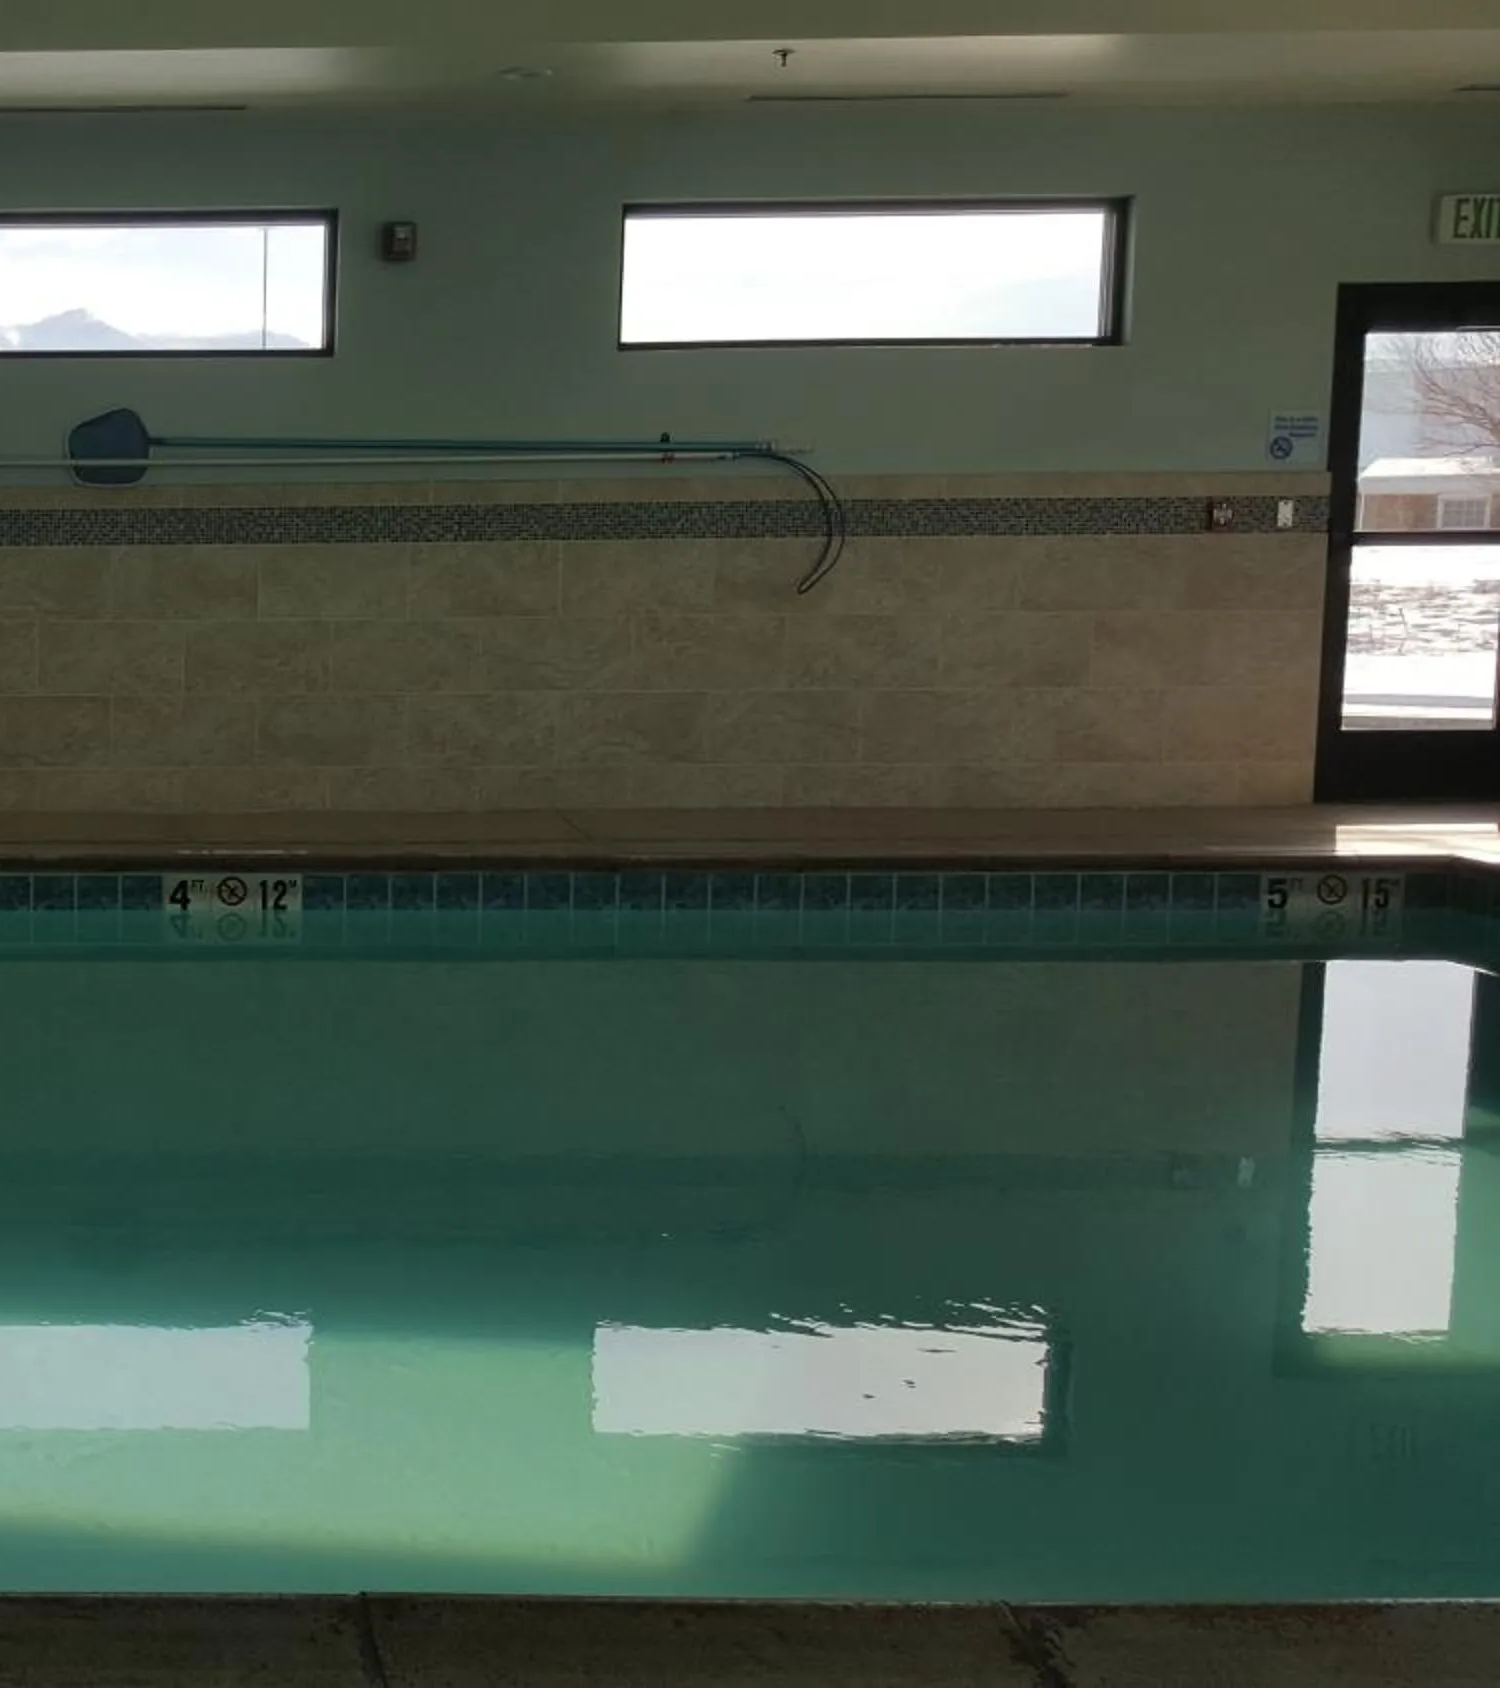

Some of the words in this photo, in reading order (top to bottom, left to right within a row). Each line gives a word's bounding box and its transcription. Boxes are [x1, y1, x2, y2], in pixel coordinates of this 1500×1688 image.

[168, 879, 192, 911] 4
[259, 879, 288, 911] 12
[1267, 878, 1288, 909] 5
